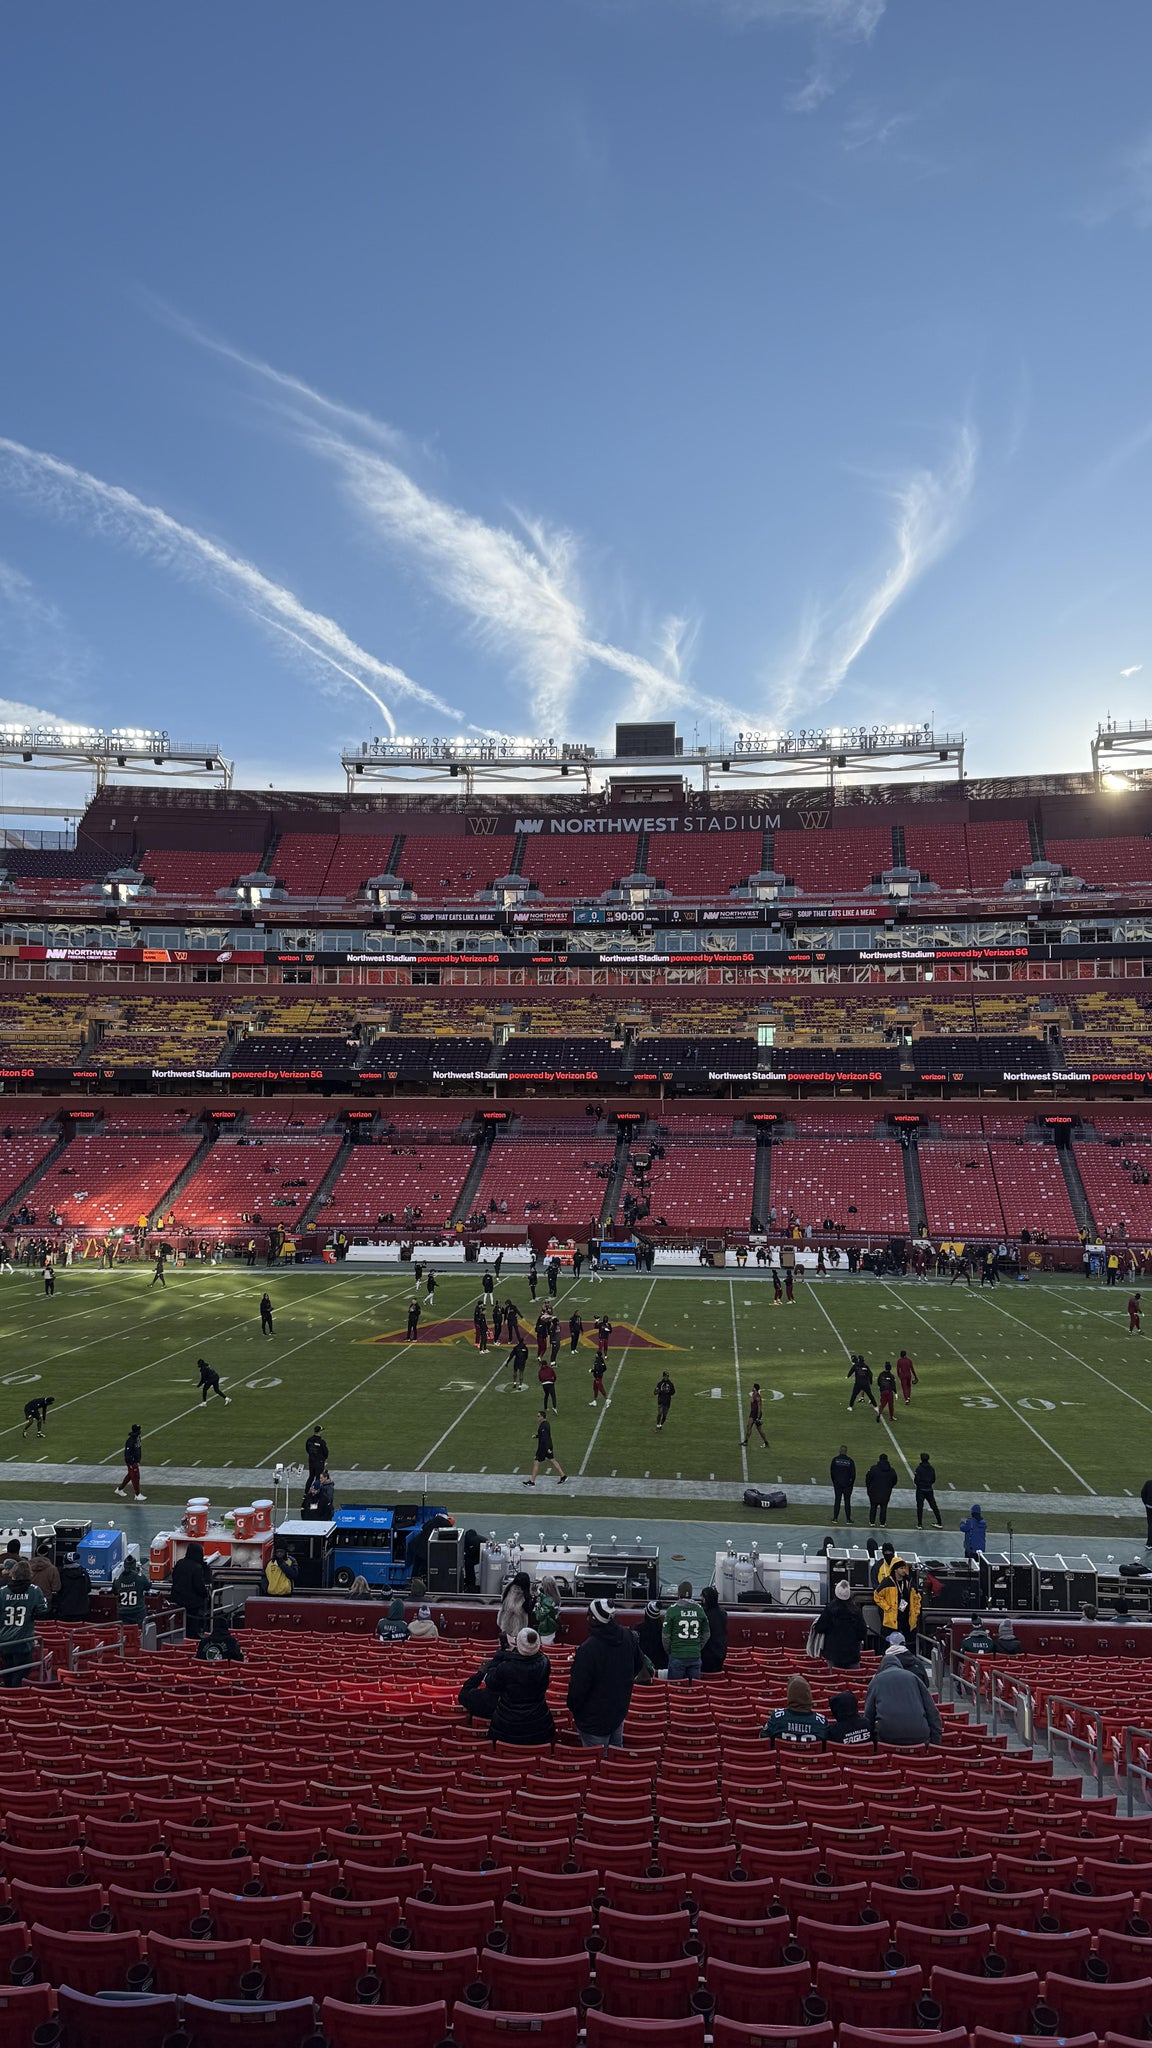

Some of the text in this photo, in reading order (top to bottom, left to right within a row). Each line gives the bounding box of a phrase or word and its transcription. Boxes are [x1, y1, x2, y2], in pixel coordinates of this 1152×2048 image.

[551, 818, 678, 833] NORTHWEST
[684, 815, 781, 831] STADIUM
[420, 913, 434, 921] SOUP
[435, 913, 448, 921] THAT
[449, 913, 462, 921] EATS
[463, 913, 474, 921] LIKE
[475, 913, 479, 921] A
[591, 911, 598, 920] 0
[615, 911, 644, 921] 90:00
[673, 910, 679, 919] 0
[855, 909, 860, 917] A
[599, 953, 754, 963] Northwest Stadium powered by Verizon 5G
[859, 948, 1028, 959] Northwest Stadium powered by Verizon 5G
[346, 954, 499, 963] Northwest Stadium powered by Verizon 5G
[21, 1069, 34, 1077] 5G
[152, 1070, 323, 1079] Northwest Stadium powered by Verizon 5G
[433, 1071, 598, 1080] Northwest Stadium powered by Verizon 5G
[709, 1072, 882, 1081] Northwest Stadium powered by Verizon 5G
[1003, 1072, 1051, 1080] Northwest
[1052, 1072, 1090, 1080] Stadium
[1091, 1072, 1133, 1082] powered
[1134, 1072, 1146, 1082] by
[189, 1516, 196, 1525] G
[256, 1512, 264, 1520] G
[236, 1518, 244, 1527] G
[120, 1590, 137, 1606] 26
[4, 1605, 27, 1626] 33
[678, 1619, 700, 1639] 33
[787, 1722, 812, 1734] BARKLEY
[843, 1731, 871, 1745] EAGLES
